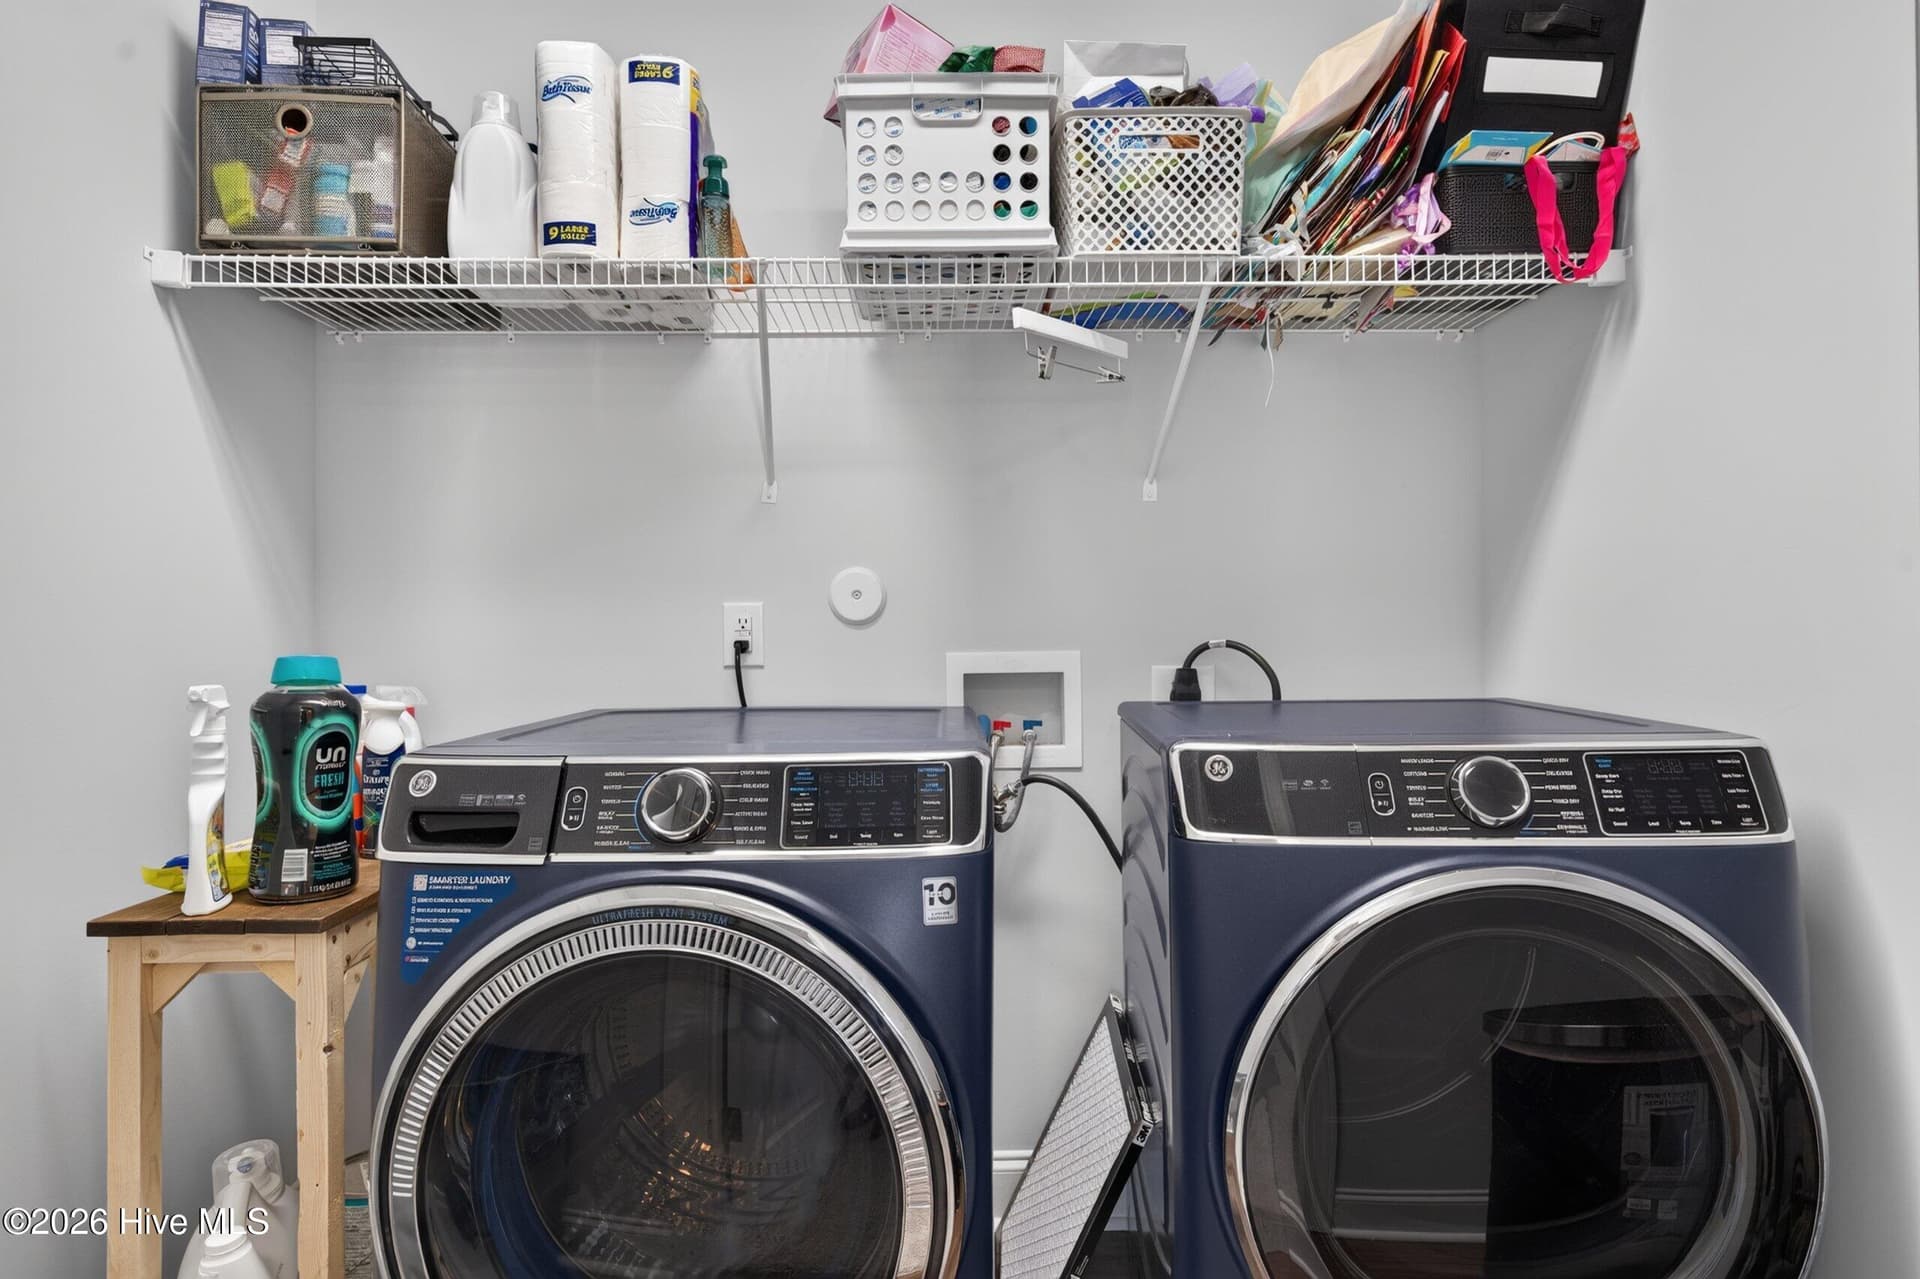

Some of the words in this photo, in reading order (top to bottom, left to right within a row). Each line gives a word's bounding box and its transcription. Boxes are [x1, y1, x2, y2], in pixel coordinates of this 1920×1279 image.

[549, 226, 559, 240] 9
[469, 876, 511, 884] LAUNDRY
[924, 882, 956, 906] 10
[1137, 1125, 1151, 1143] 3M
